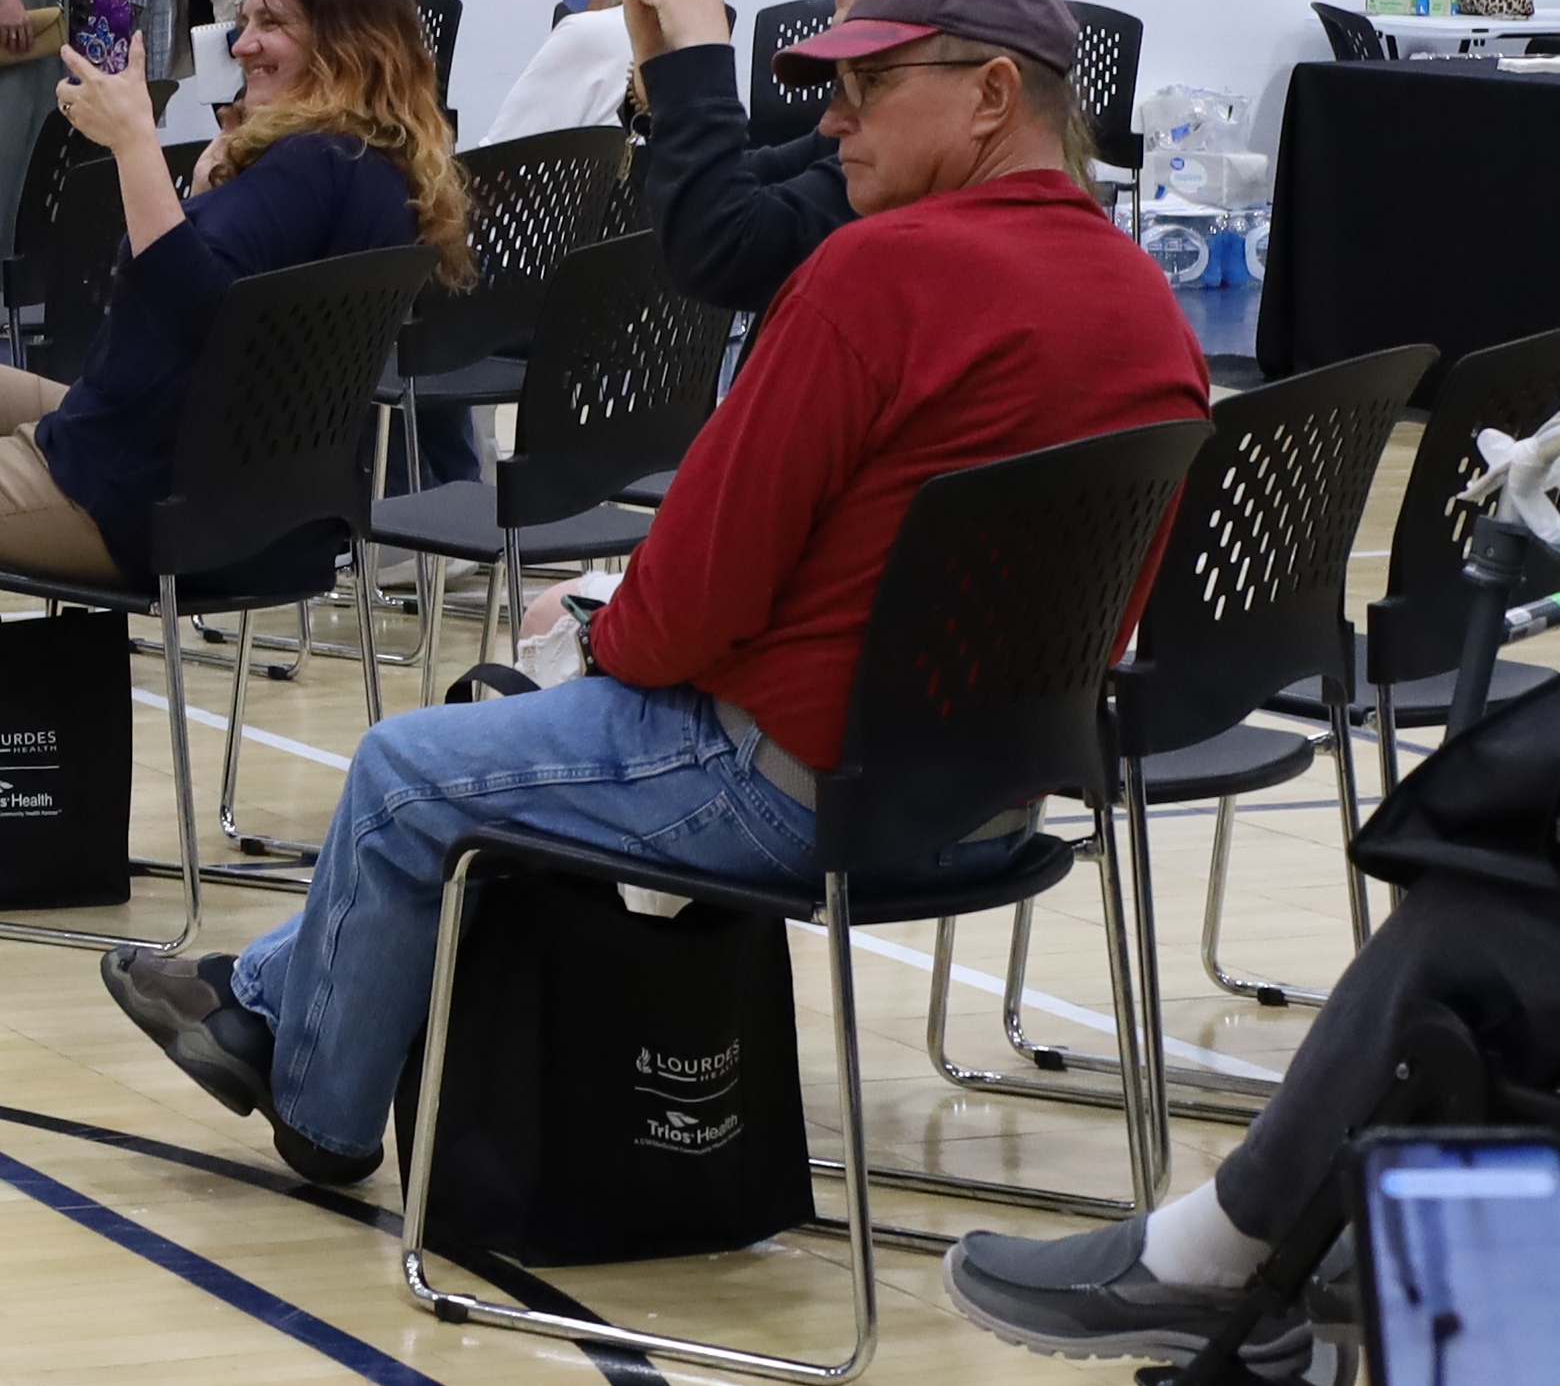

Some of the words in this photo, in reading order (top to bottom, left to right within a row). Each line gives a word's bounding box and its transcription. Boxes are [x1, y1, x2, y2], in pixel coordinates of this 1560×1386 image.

[13, 745, 57, 753] HEALTH
[11, 792, 53, 808] Health
[656, 1038, 740, 1075] LOURDES
[647, 1119, 692, 1145] Trios
[697, 1114, 738, 1145] Health
